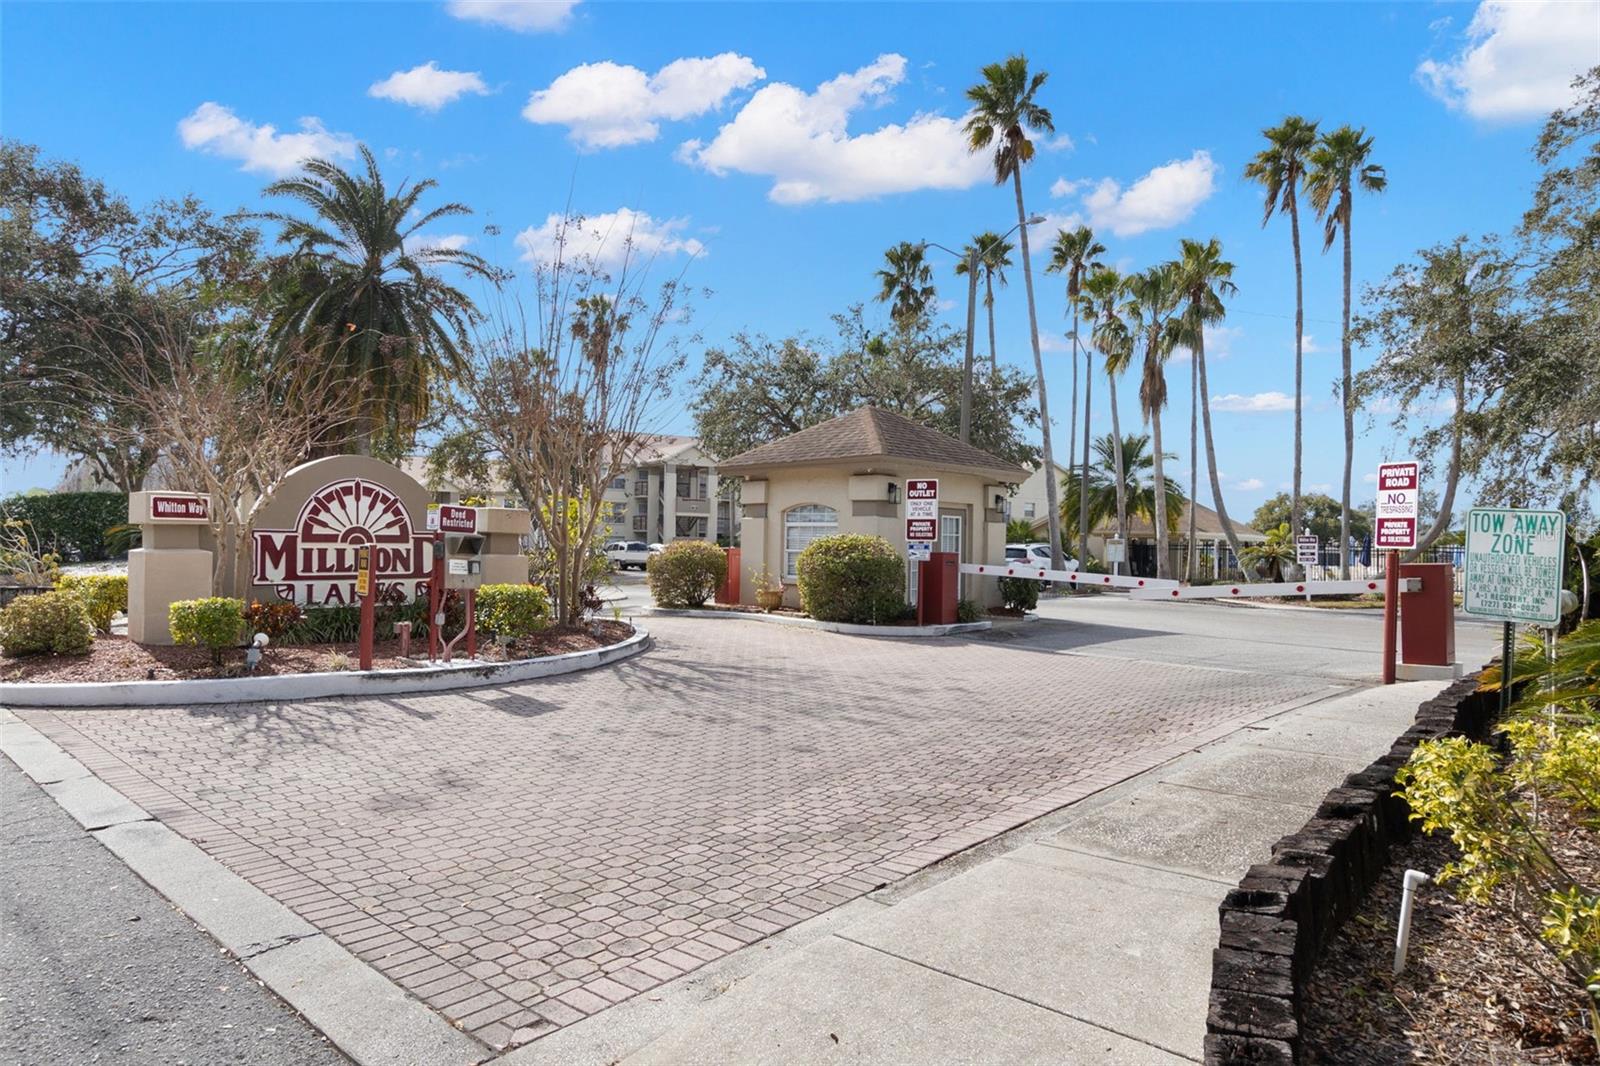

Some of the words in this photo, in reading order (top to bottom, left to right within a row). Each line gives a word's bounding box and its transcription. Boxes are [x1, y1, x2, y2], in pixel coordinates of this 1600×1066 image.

[1382, 467, 1415, 478] PRIVATE
[1385, 478, 1410, 487] ROAD
[1387, 493, 1406, 504] NO
[157, 501, 186, 513] Whitton
[188, 502, 203, 516] Way
[450, 509, 466, 519] Deed
[1380, 505, 1413, 514] TRESPASSING
[442, 517, 474, 528] Restricted
[1472, 513, 1505, 533] TOW
[1514, 513, 1559, 536] AWAY
[1491, 534, 1535, 555] ZONE
[257, 534, 435, 581] MILLOND
[1470, 553, 1520, 565] UNAUTHORIZED
[1524, 556, 1557, 567] VEHICLES
[1481, 562, 1505, 574] VESSELS
[1508, 566, 1521, 576] WILL
[1525, 567, 1532, 577] BE
[1469, 573, 1485, 583] AWAY
[1488, 574, 1494, 583] AT
[1526, 577, 1556, 589] EXPENSE
[1481, 600, 1499, 608] (727)
